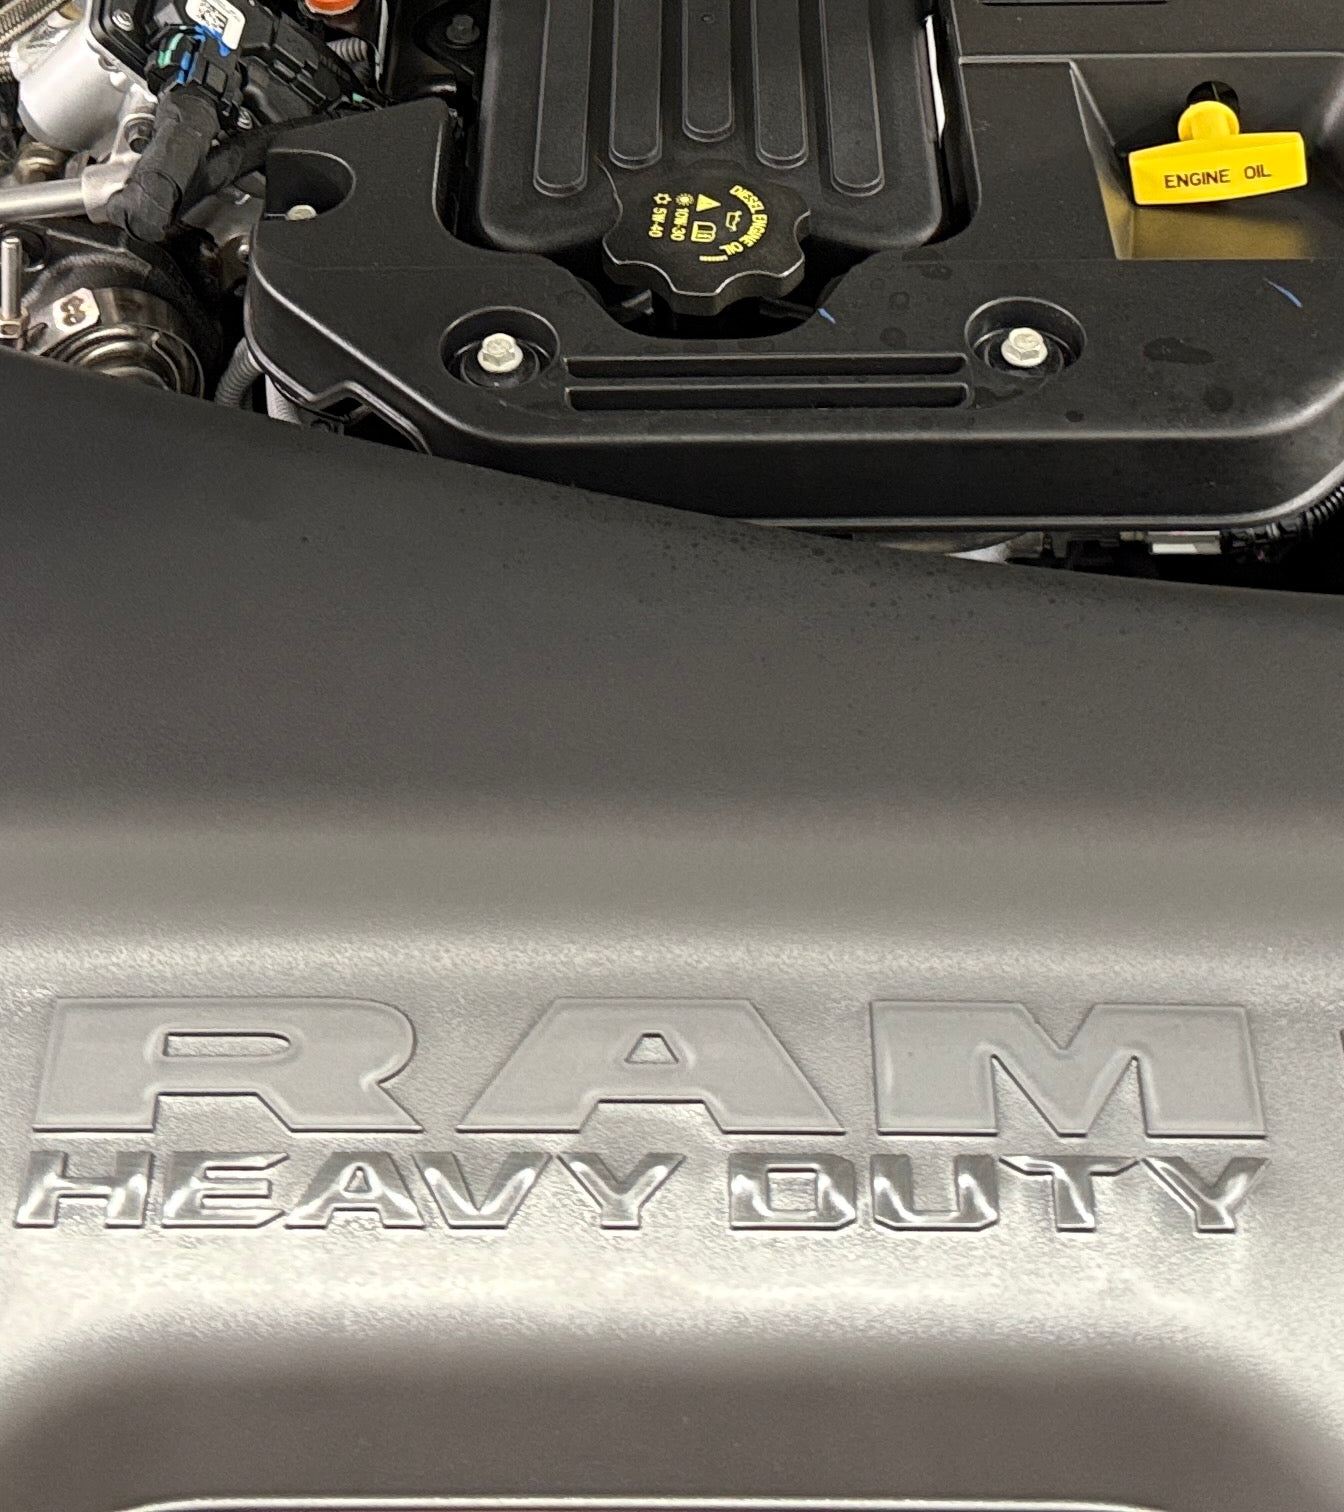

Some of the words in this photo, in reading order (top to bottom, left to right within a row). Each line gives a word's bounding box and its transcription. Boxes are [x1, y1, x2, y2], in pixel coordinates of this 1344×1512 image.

[1164, 168, 1231, 189] ENGINE
[1244, 164, 1272, 180] OIL
[729, 185, 765, 213] DIESEL
[649, 207, 667, 238] 5W-40
[670, 208, 689, 241] 10W-30
[738, 213, 768, 248] ENGINE
[719, 241, 745, 256] OIL
[31, 995, 1268, 1139] RAM
[13, 1149, 685, 1231] HEAVY
[728, 1151, 1269, 1234] DUTY
